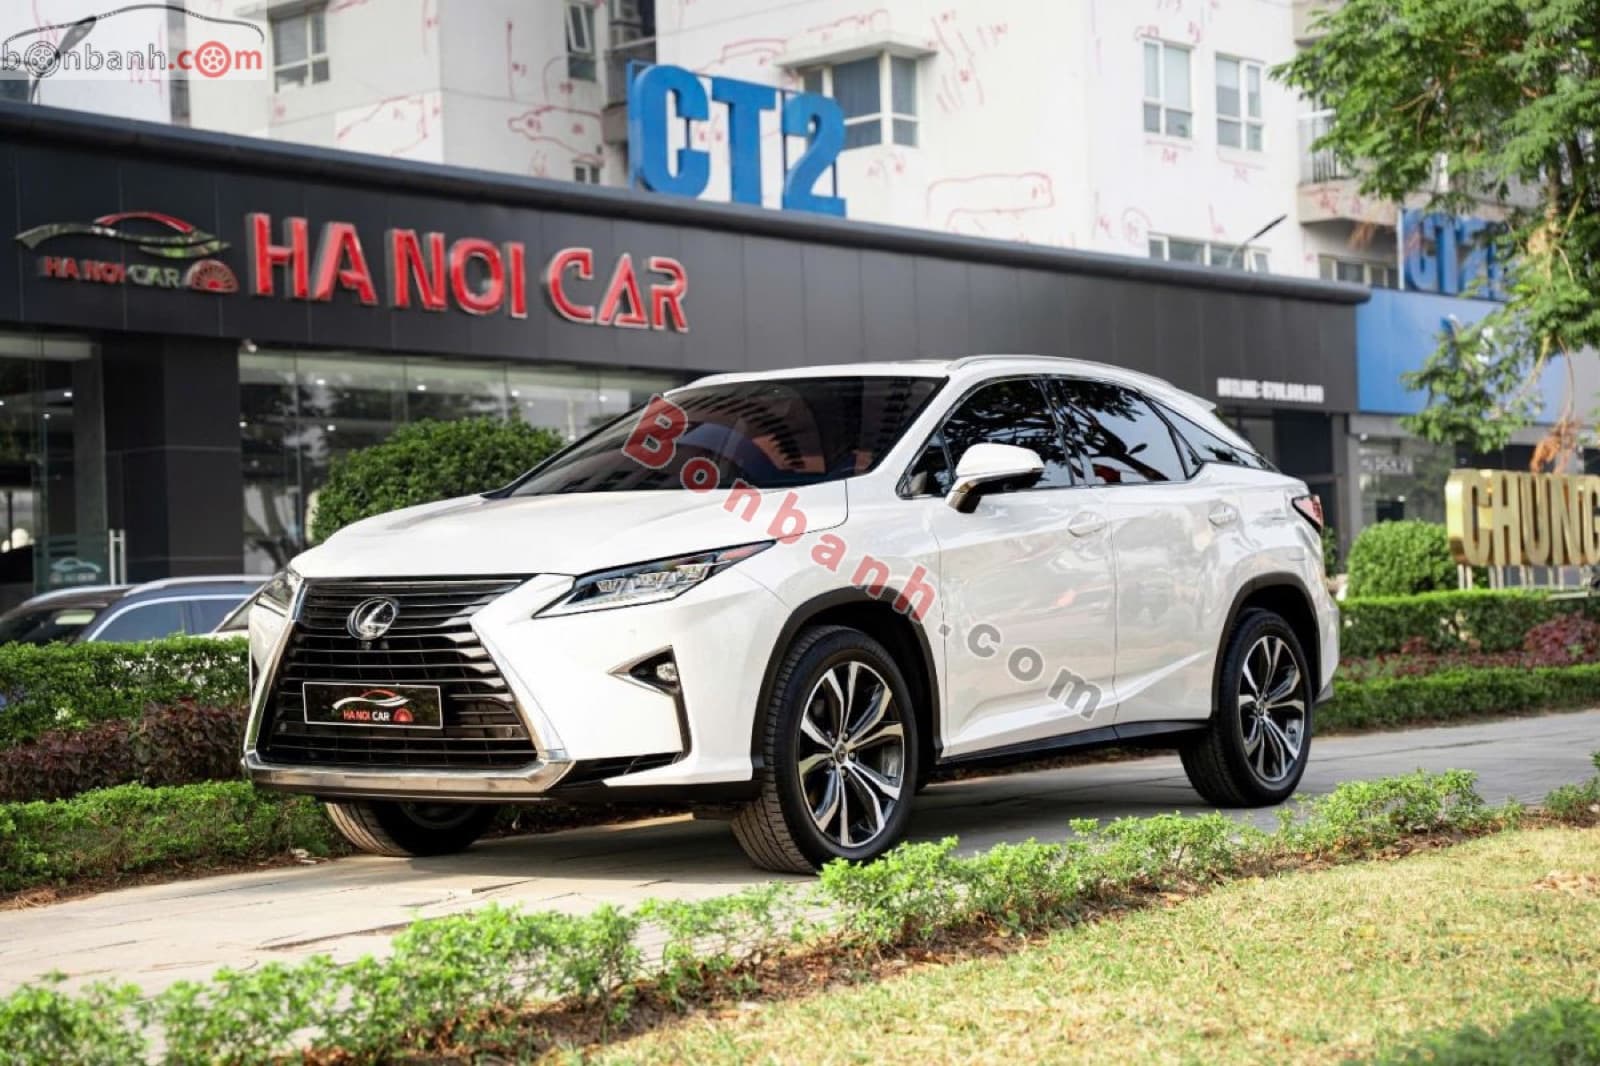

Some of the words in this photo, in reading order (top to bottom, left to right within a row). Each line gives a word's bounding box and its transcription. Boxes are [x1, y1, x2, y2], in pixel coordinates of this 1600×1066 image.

[629, 63, 847, 217] CT2
[127, 264, 181, 289] CAR
[247, 212, 378, 305] HA
[388, 228, 527, 319] NOI
[546, 247, 690, 333] CAR
[371, 711, 391, 722] CAR
